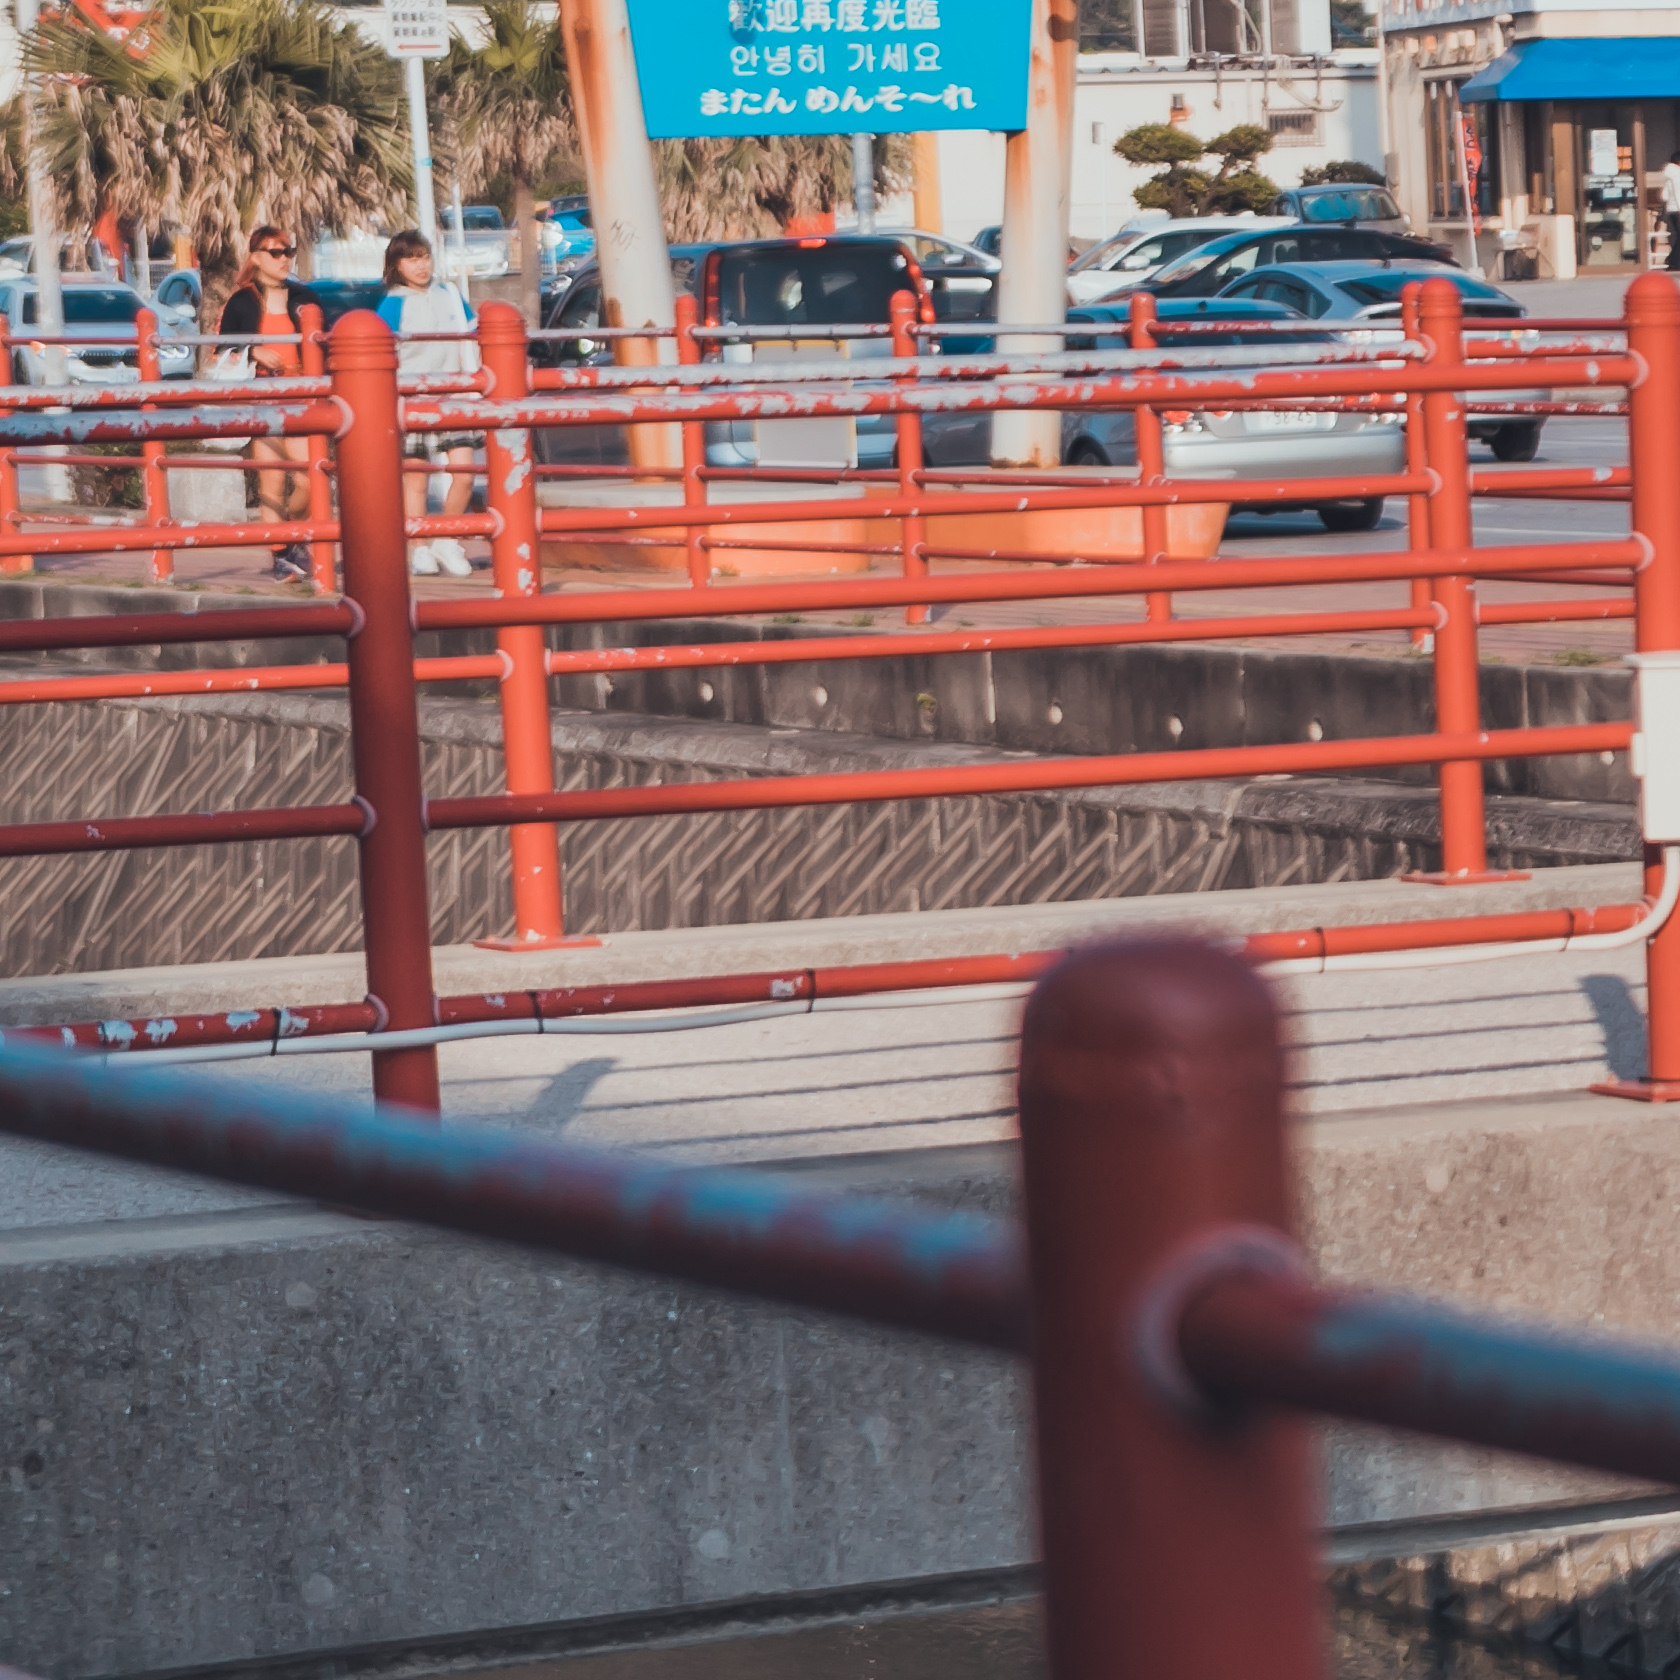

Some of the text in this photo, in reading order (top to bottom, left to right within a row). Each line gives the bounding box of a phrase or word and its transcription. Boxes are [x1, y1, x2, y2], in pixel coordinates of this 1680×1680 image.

[730, 44, 941, 77] 안녕히 가세요
[699, 86, 796, 117] またん
